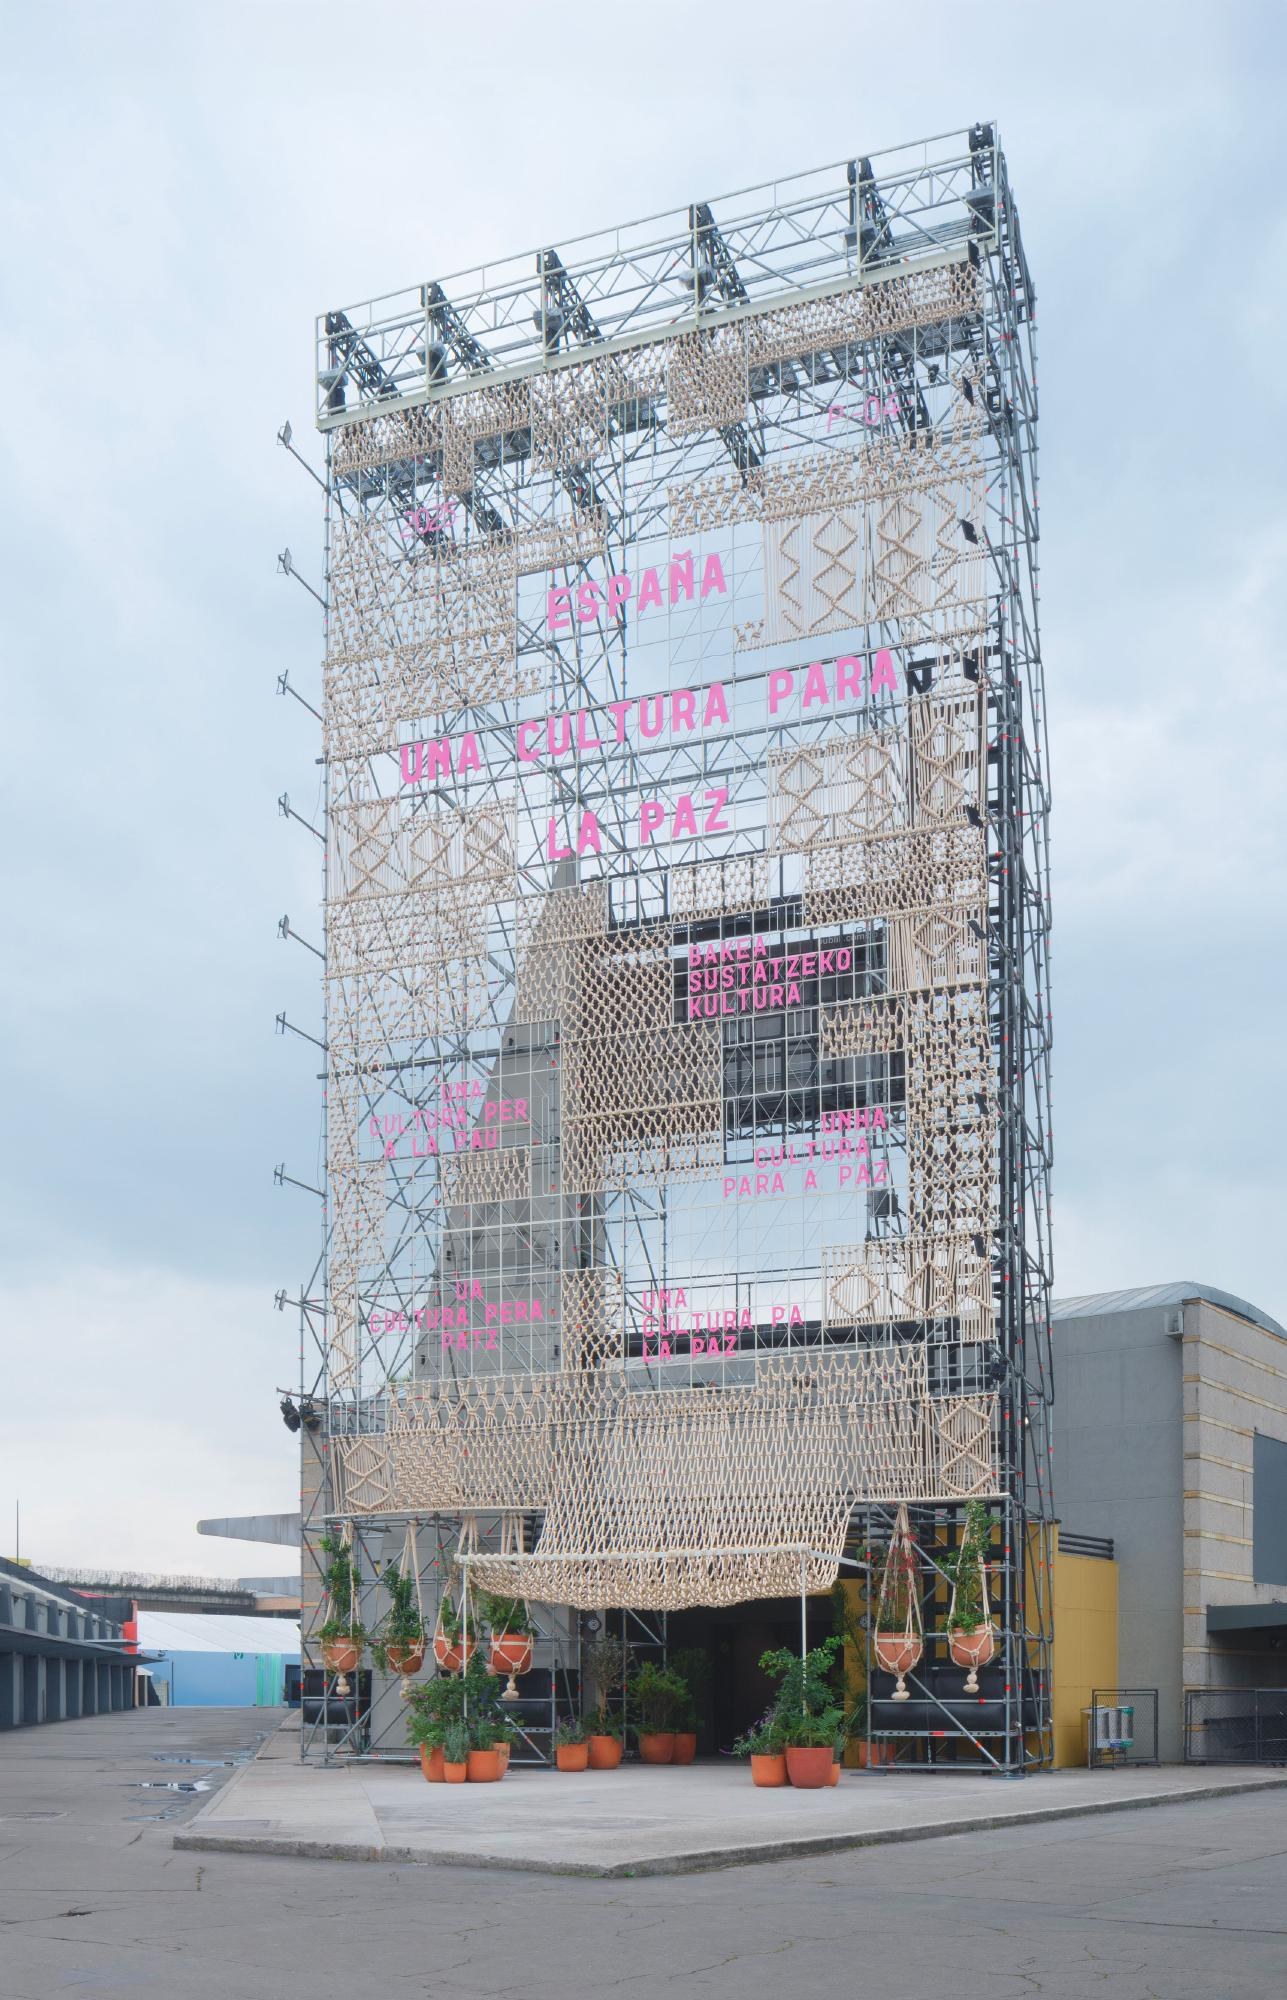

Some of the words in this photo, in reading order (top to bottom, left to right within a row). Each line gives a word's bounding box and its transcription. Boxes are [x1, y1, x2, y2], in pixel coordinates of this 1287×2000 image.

[547, 549, 728, 631] ESPAÑA
[400, 732, 482, 784] UNA
[516, 682, 730, 762] CULTURA
[768, 648, 899, 714] PARA
[547, 810, 602, 861] LA
[639, 787, 730, 845] PAZ
[688, 935, 768, 967] BAKEA
[688, 948, 853, 993] SUSTATZEKO
[688, 984, 802, 1020] KULTURA
[440, 1080, 484, 1104] UNA
[369, 1107, 467, 1137] CULTURA
[484, 1098, 528, 1122] PER
[820, 1107, 887, 1135] UNHA
[383, 1140, 396, 1160] A
[411, 1136, 439, 1158] LA
[455, 1127, 499, 1154] PAU
[754, 1137, 870, 1169] CULTURA
[722, 1172, 785, 1199] PARA
[804, 1169, 818, 1189] A
[838, 1161, 888, 1186] PAZ
[455, 1279, 484, 1301] UA
[641, 1287, 688, 1312] UNA
[368, 1306, 469, 1334] CULTURA
[485, 1299, 544, 1326] PERA
[641, 1307, 753, 1338] CULTURA
[771, 1304, 805, 1328] PA
[641, 1340, 673, 1363] LA
[691, 1335, 737, 1359] PAZ
